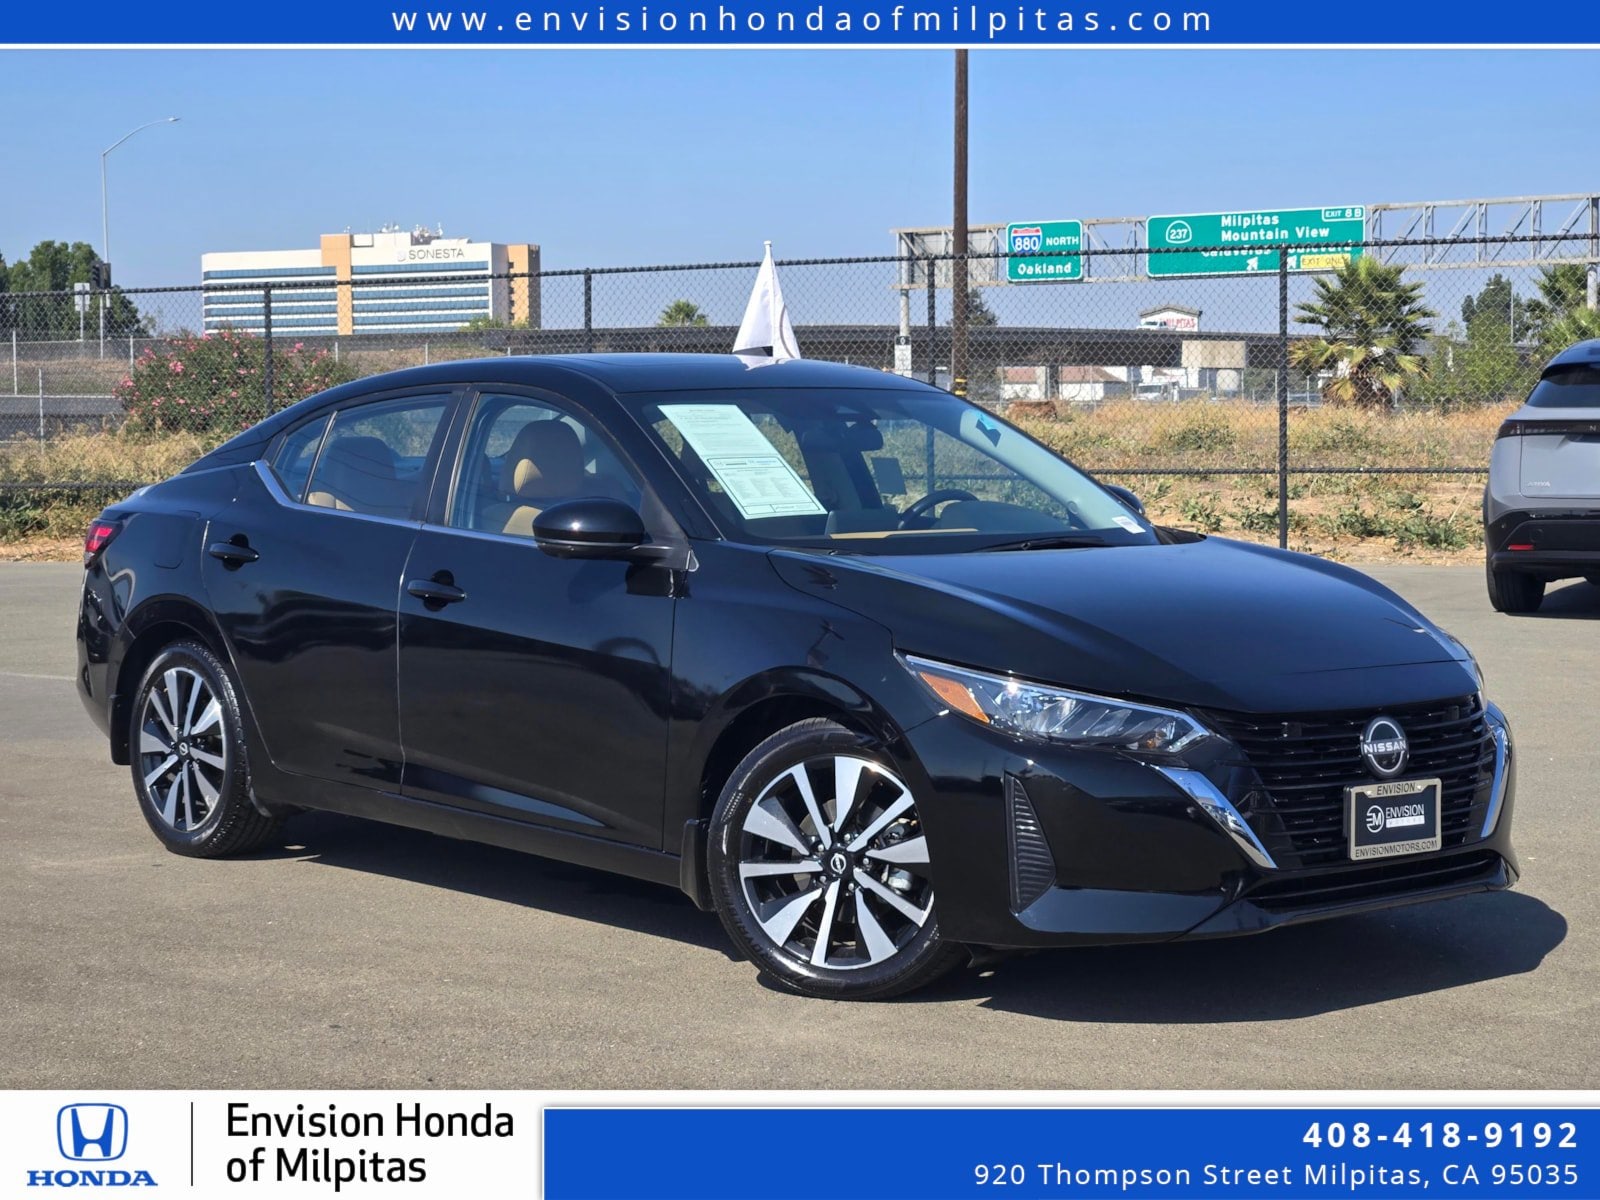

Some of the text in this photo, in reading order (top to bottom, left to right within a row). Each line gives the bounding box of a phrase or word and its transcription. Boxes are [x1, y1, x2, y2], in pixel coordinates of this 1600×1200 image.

[1325, 209, 1341, 218] EXIT
[1221, 214, 1279, 229] Milpitas
[1169, 229, 1187, 239] 237
[1221, 225, 1330, 242] Mountain View
[1015, 236, 1079, 251] 880 NORTH
[408, 248, 465, 260] SONESTA
[1017, 261, 1072, 276] Oakland
[1302, 257, 1320, 266] EXIT
[1363, 740, 1406, 754] NISSAN
[1377, 782, 1416, 796] ENVISION
[1385, 804, 1425, 819] ENVISION
[1355, 839, 1438, 858] ENVISIONMOTORS.COM
